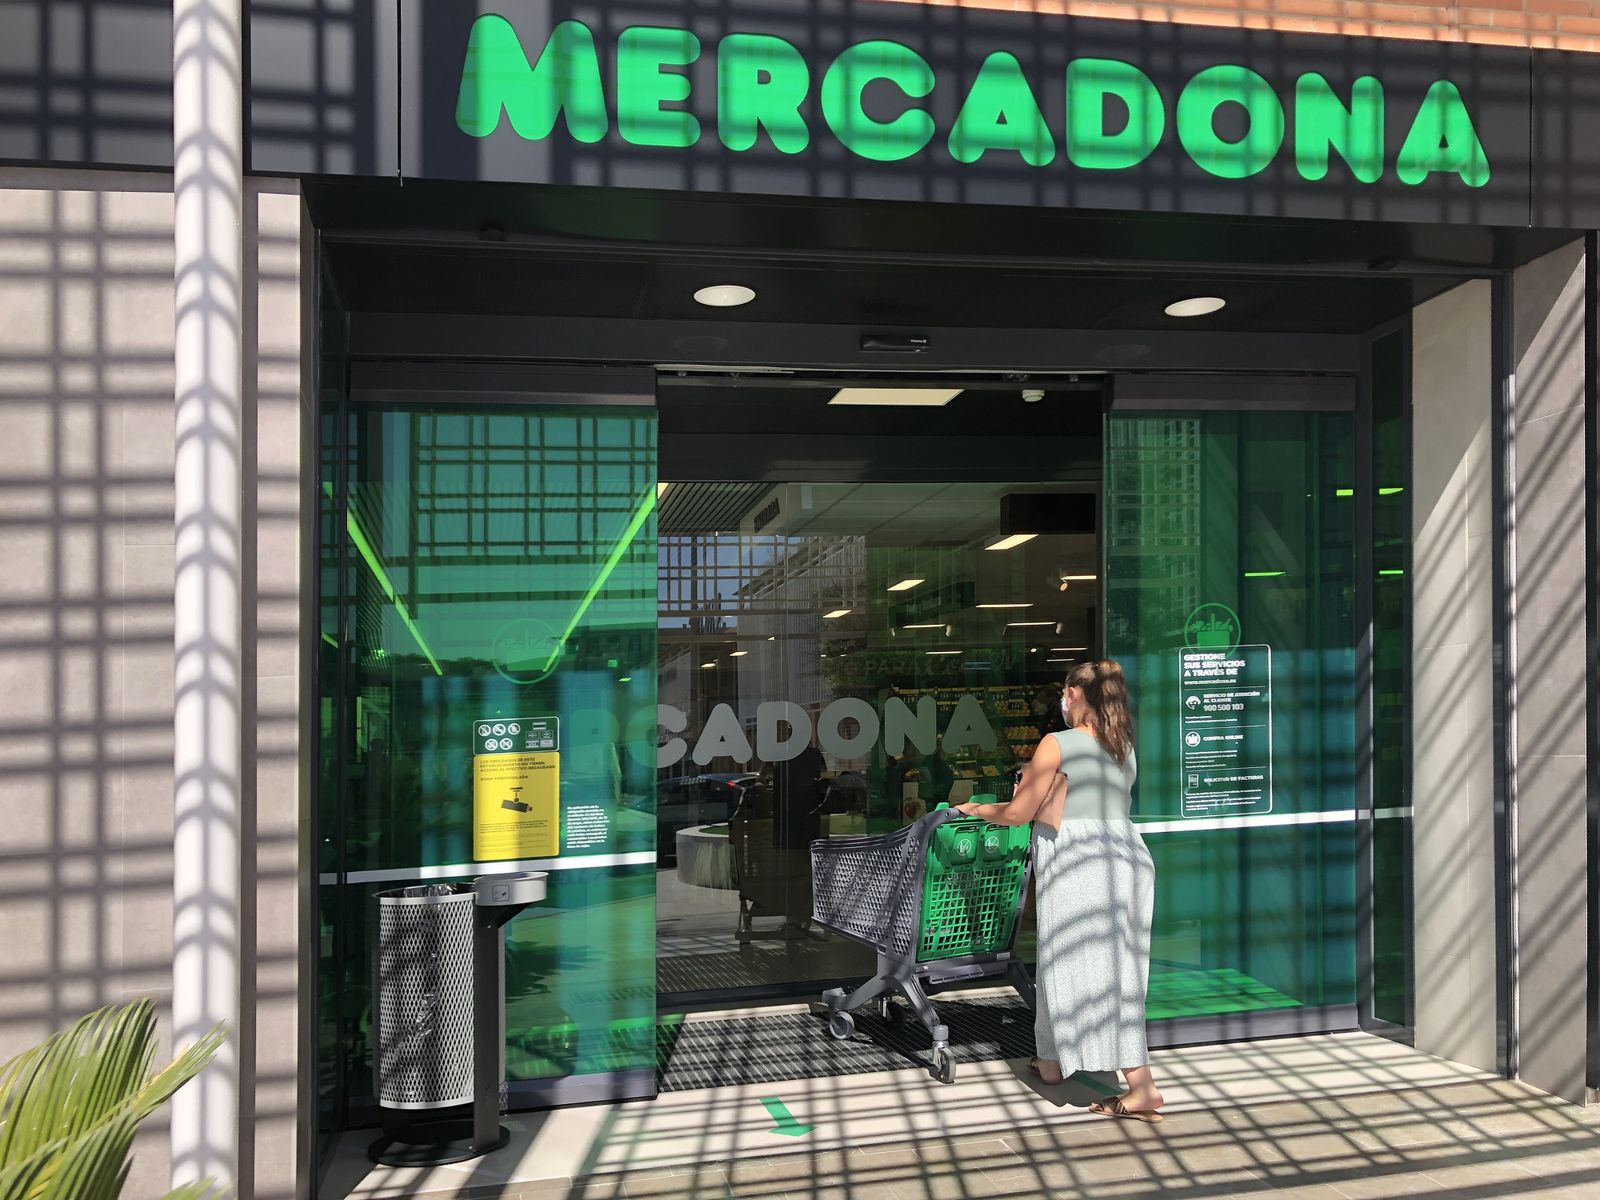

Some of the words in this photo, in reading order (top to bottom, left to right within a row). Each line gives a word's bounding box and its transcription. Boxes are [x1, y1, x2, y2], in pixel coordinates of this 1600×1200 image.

[455, 14, 1491, 188] MERCADONA
[1184, 653, 1226, 661] GESTIONE
[1202, 660, 1246, 668] SERVICIOS
[1192, 668, 1225, 676] TRAVÉS
